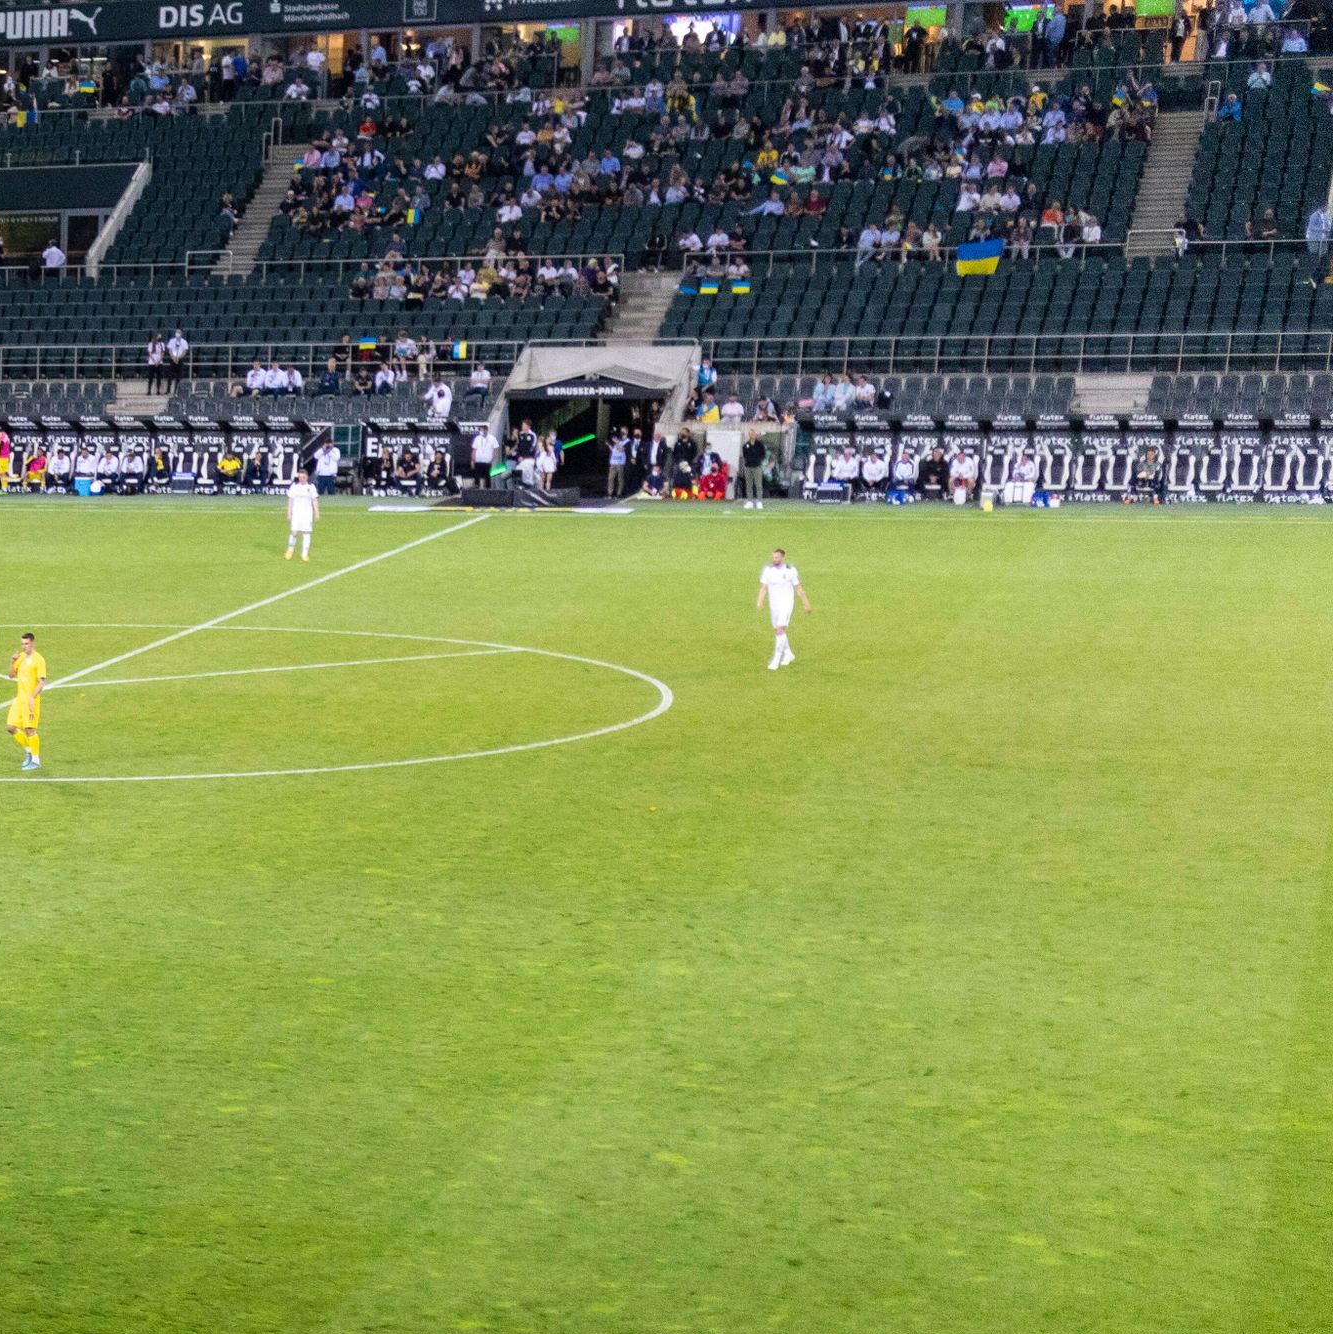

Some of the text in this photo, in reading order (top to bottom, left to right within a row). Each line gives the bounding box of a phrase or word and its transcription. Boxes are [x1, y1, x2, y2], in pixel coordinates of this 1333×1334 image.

[159, 3, 243, 28] DIS AG
[546, 387, 624, 396] BORUSSIA-PARK
